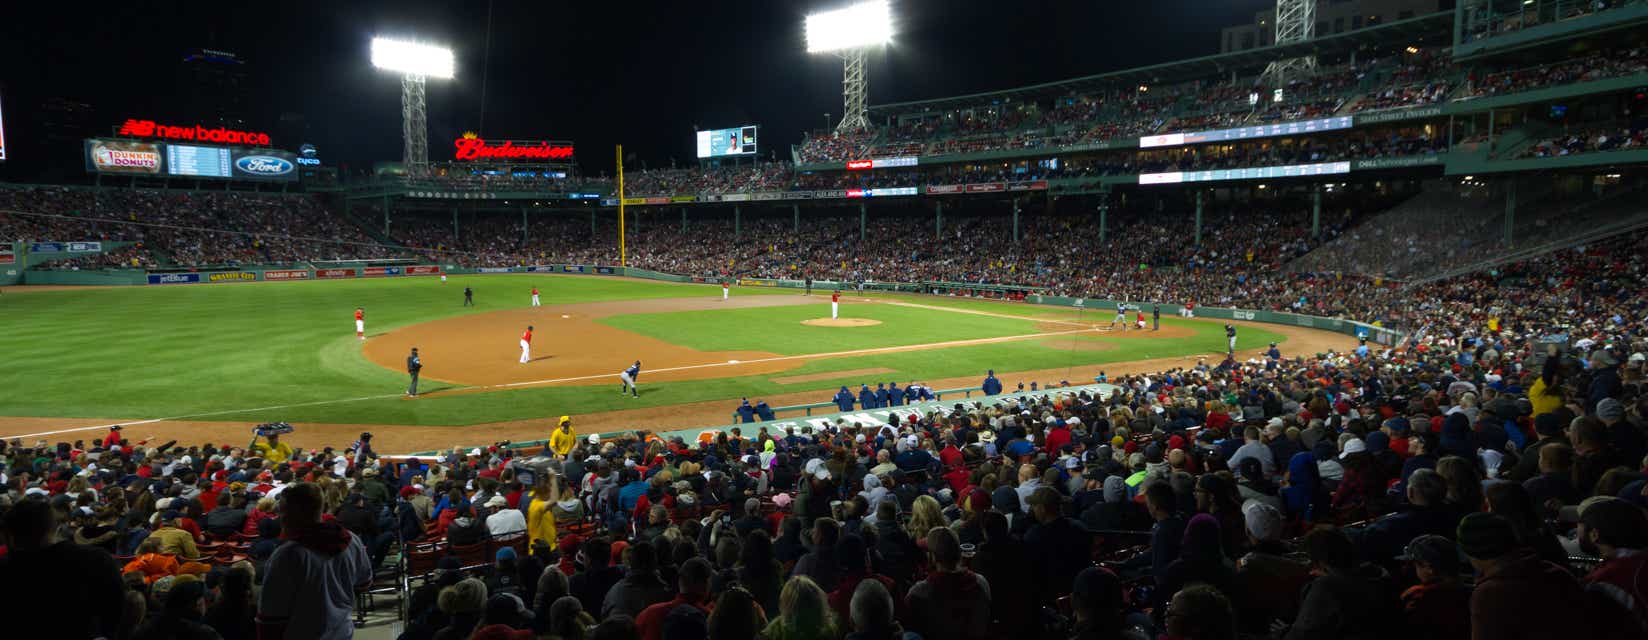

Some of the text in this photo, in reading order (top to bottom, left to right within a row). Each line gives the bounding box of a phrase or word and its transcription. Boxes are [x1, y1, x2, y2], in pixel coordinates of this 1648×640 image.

[455, 137, 574, 160] Budweiser
[114, 158, 155, 168] DONUTS
[247, 158, 283, 173] Ford
[296, 157, 320, 166] tyco
[159, 273, 189, 284] jetBlue
